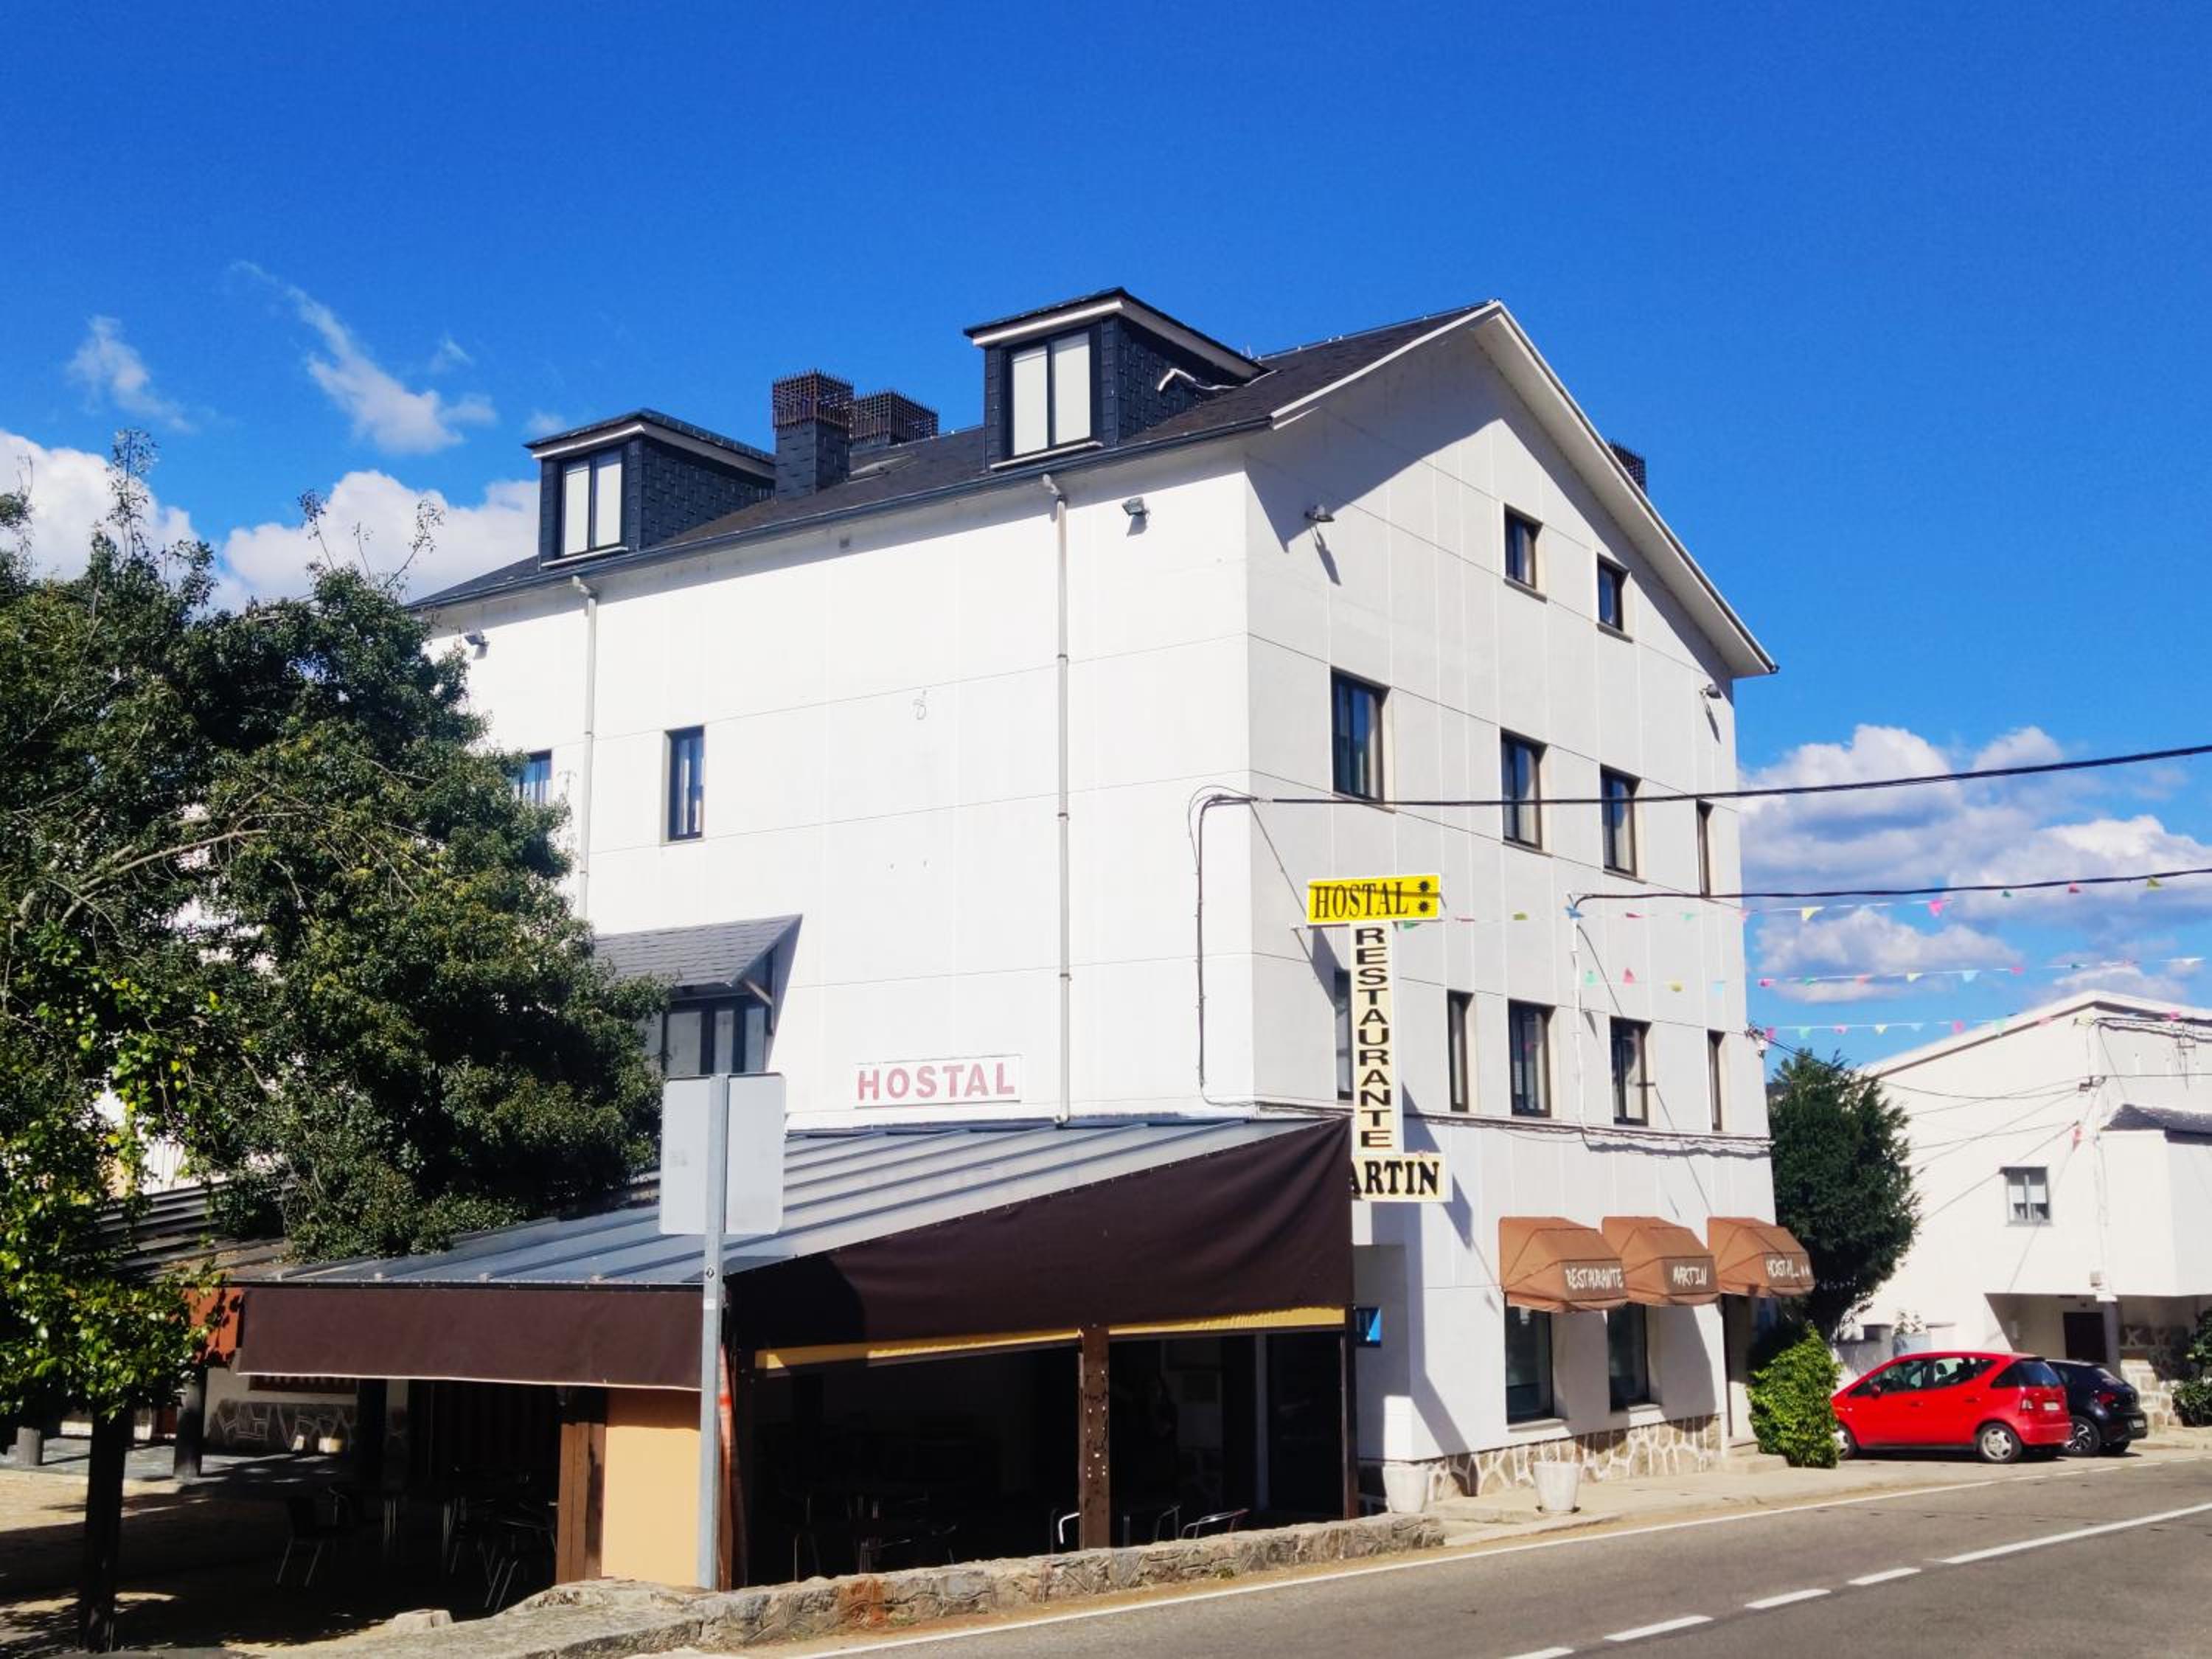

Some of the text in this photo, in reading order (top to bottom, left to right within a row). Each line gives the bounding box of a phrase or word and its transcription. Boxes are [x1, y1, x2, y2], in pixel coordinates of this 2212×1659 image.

[1313, 881, 1409, 919] HOSTAL
[1355, 927, 1393, 1149] RESTAURANTE
[858, 1062, 1015, 1101] HOSTAL
[1351, 1160, 1440, 1195] ARTIN
